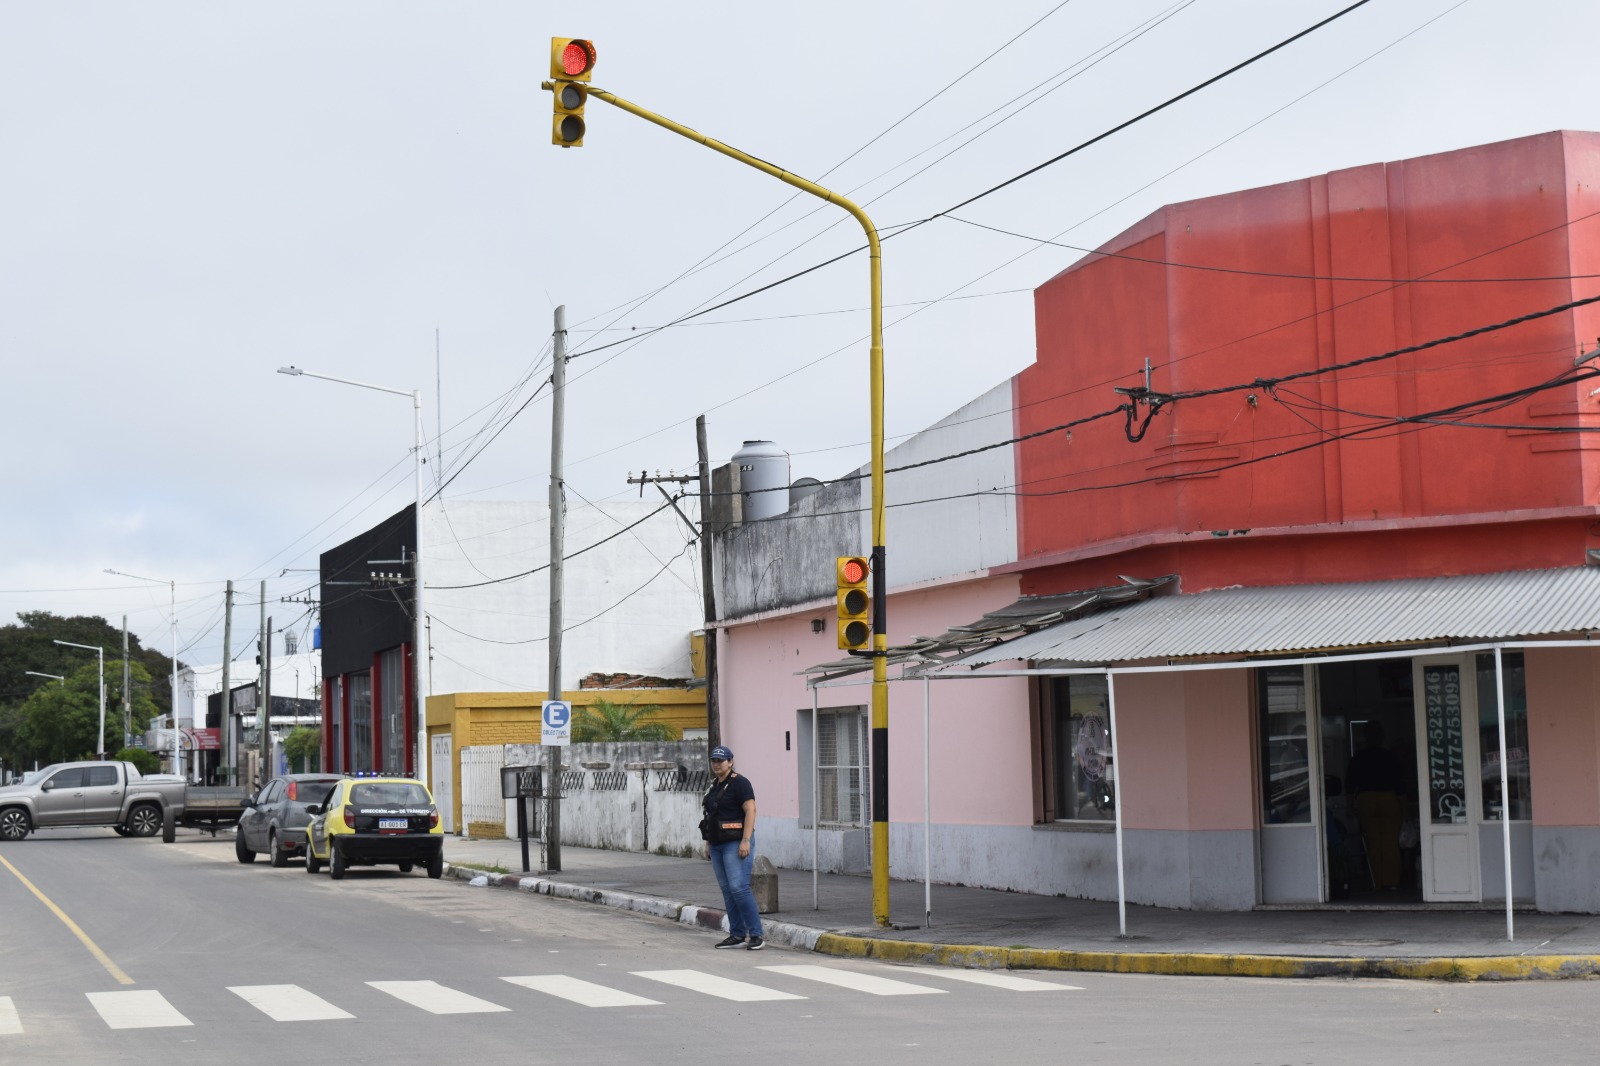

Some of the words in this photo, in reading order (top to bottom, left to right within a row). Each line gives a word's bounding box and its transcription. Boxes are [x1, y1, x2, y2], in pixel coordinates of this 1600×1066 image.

[549, 705, 564, 724] E
[1427, 671, 1446, 790] 3777-523246
[1445, 671, 1464, 790] 3777-753095
